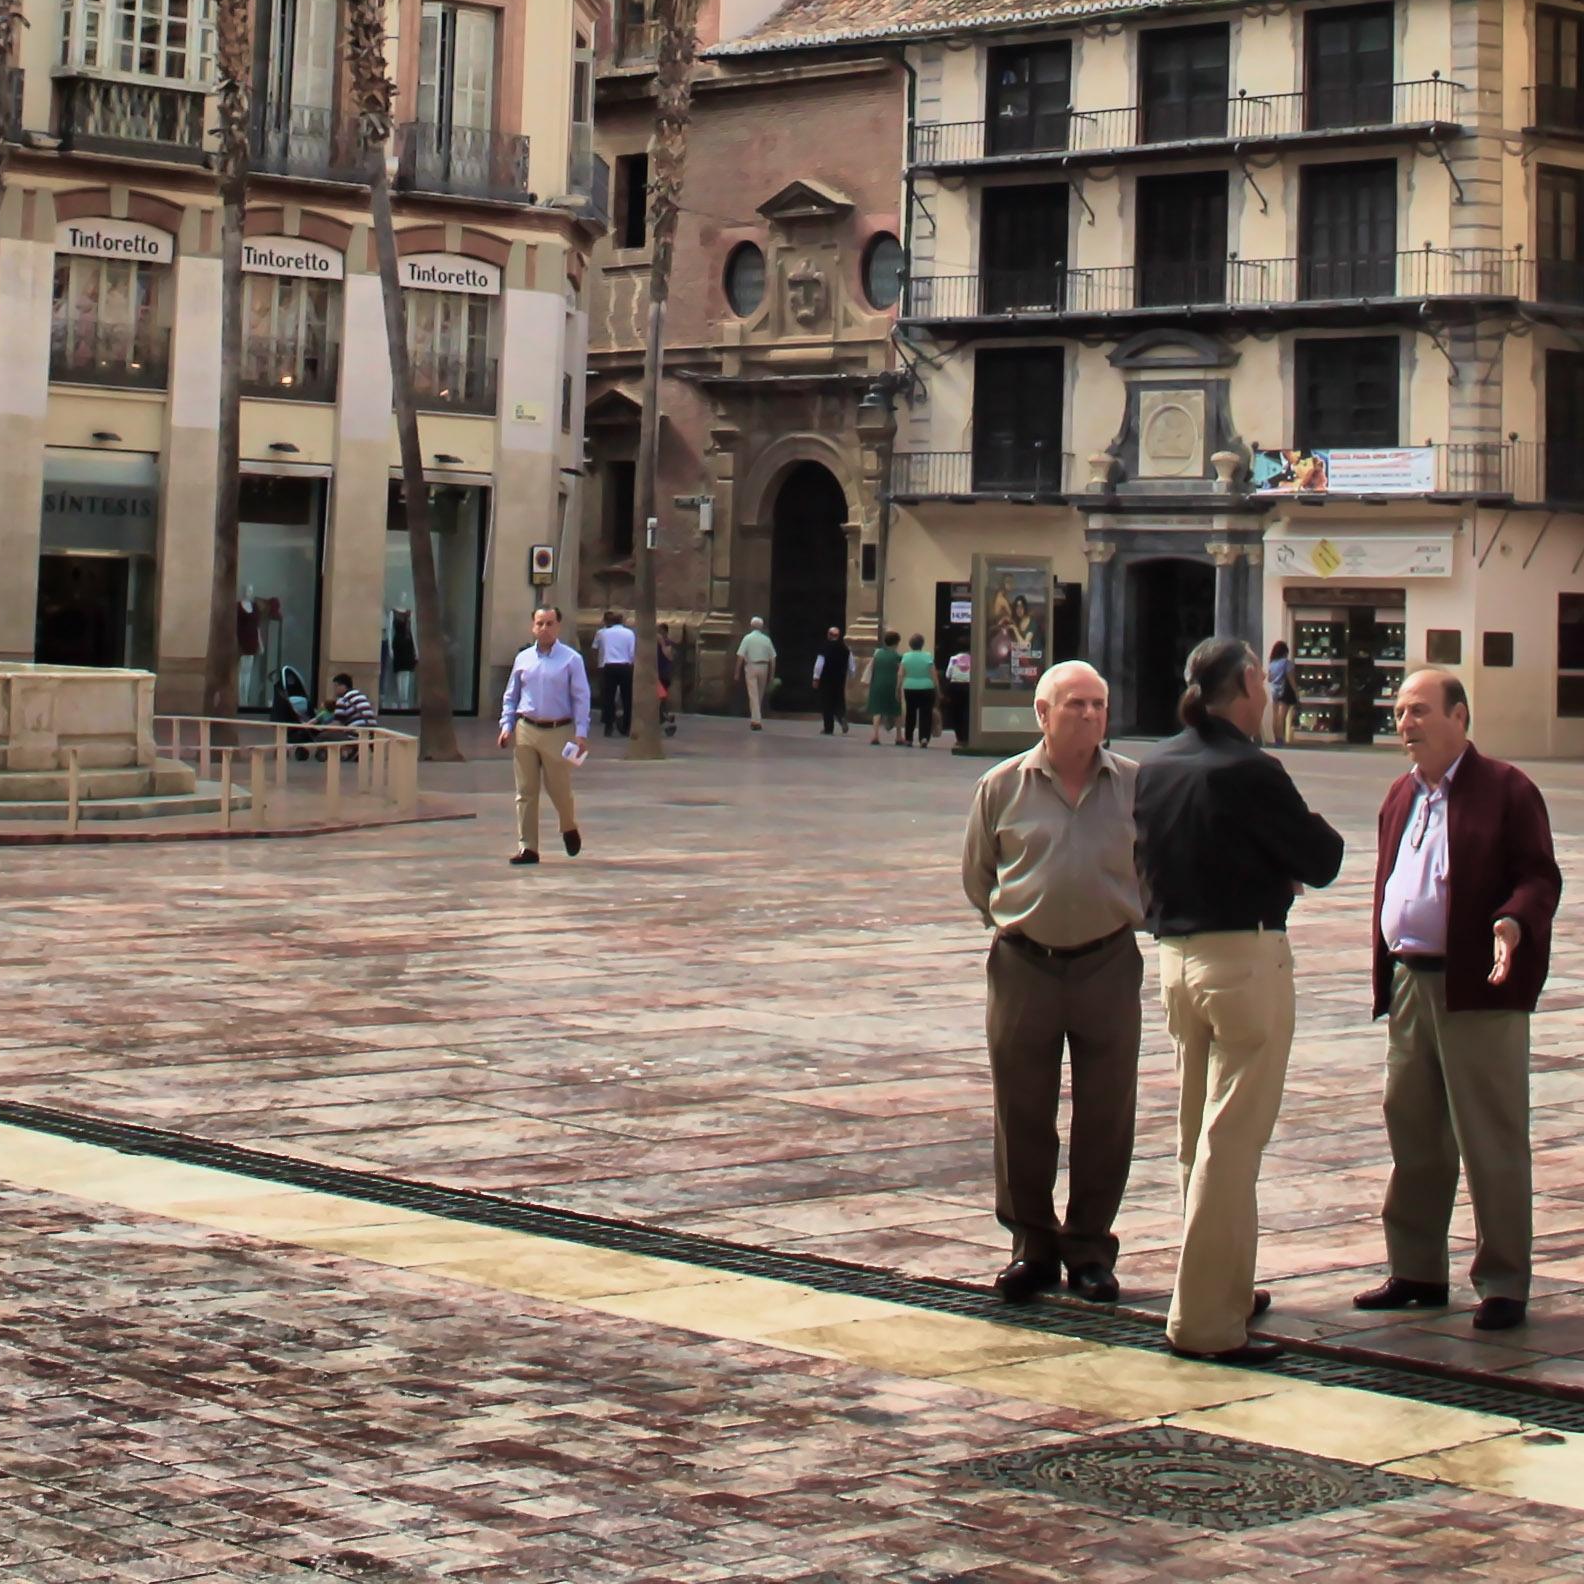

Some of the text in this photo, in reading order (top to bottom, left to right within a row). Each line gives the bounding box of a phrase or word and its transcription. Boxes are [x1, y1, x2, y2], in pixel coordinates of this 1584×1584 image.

[69, 227, 159, 255] Tintoretto
[243, 246, 329, 272] Tintoretto
[408, 263, 488, 288] Tintoretto
[45, 493, 152, 518] SÍNTESIS
